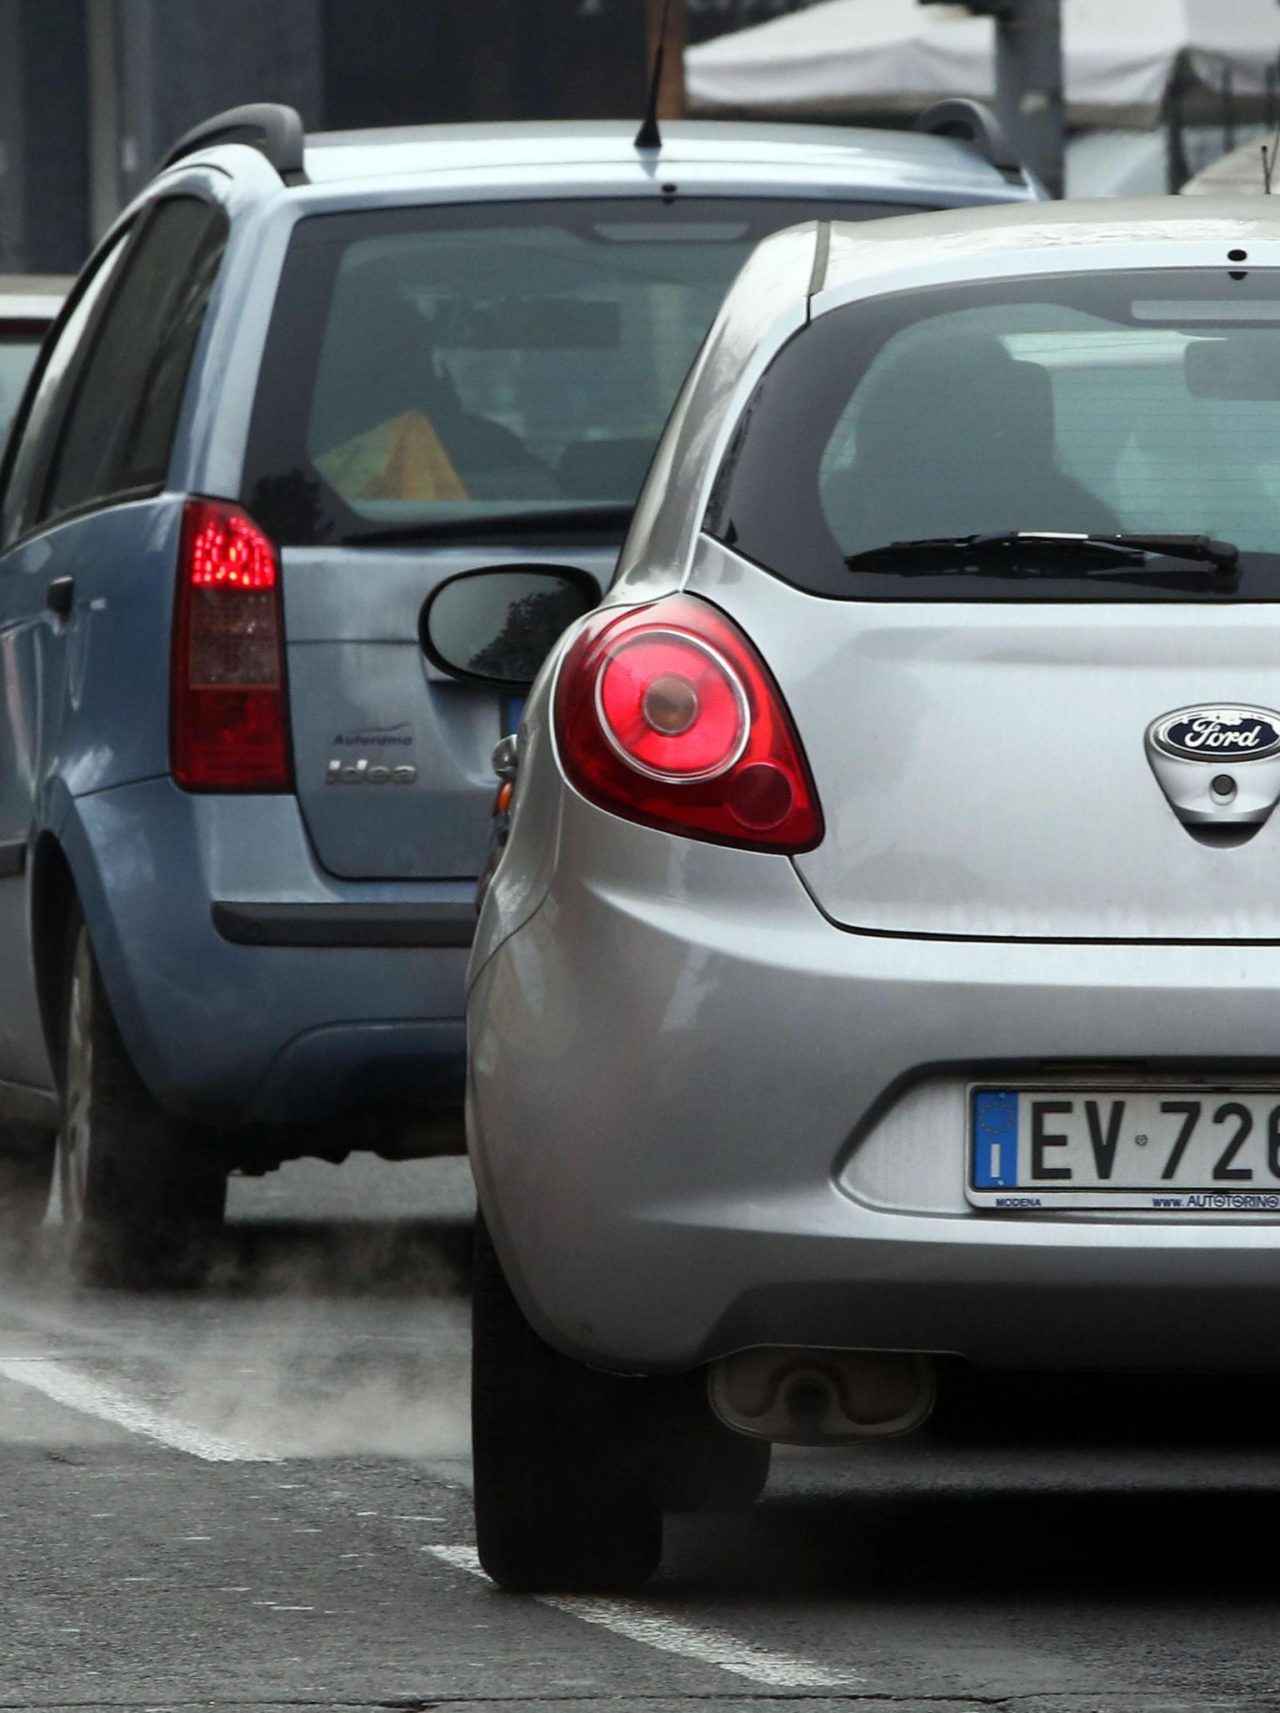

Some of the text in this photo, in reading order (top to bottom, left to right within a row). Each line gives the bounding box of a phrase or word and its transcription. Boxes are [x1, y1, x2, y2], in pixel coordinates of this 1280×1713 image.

[1184, 718, 1262, 748] Ford
[1031, 1101, 1125, 1180] EV
[995, 1198, 1042, 1207] MODENA
